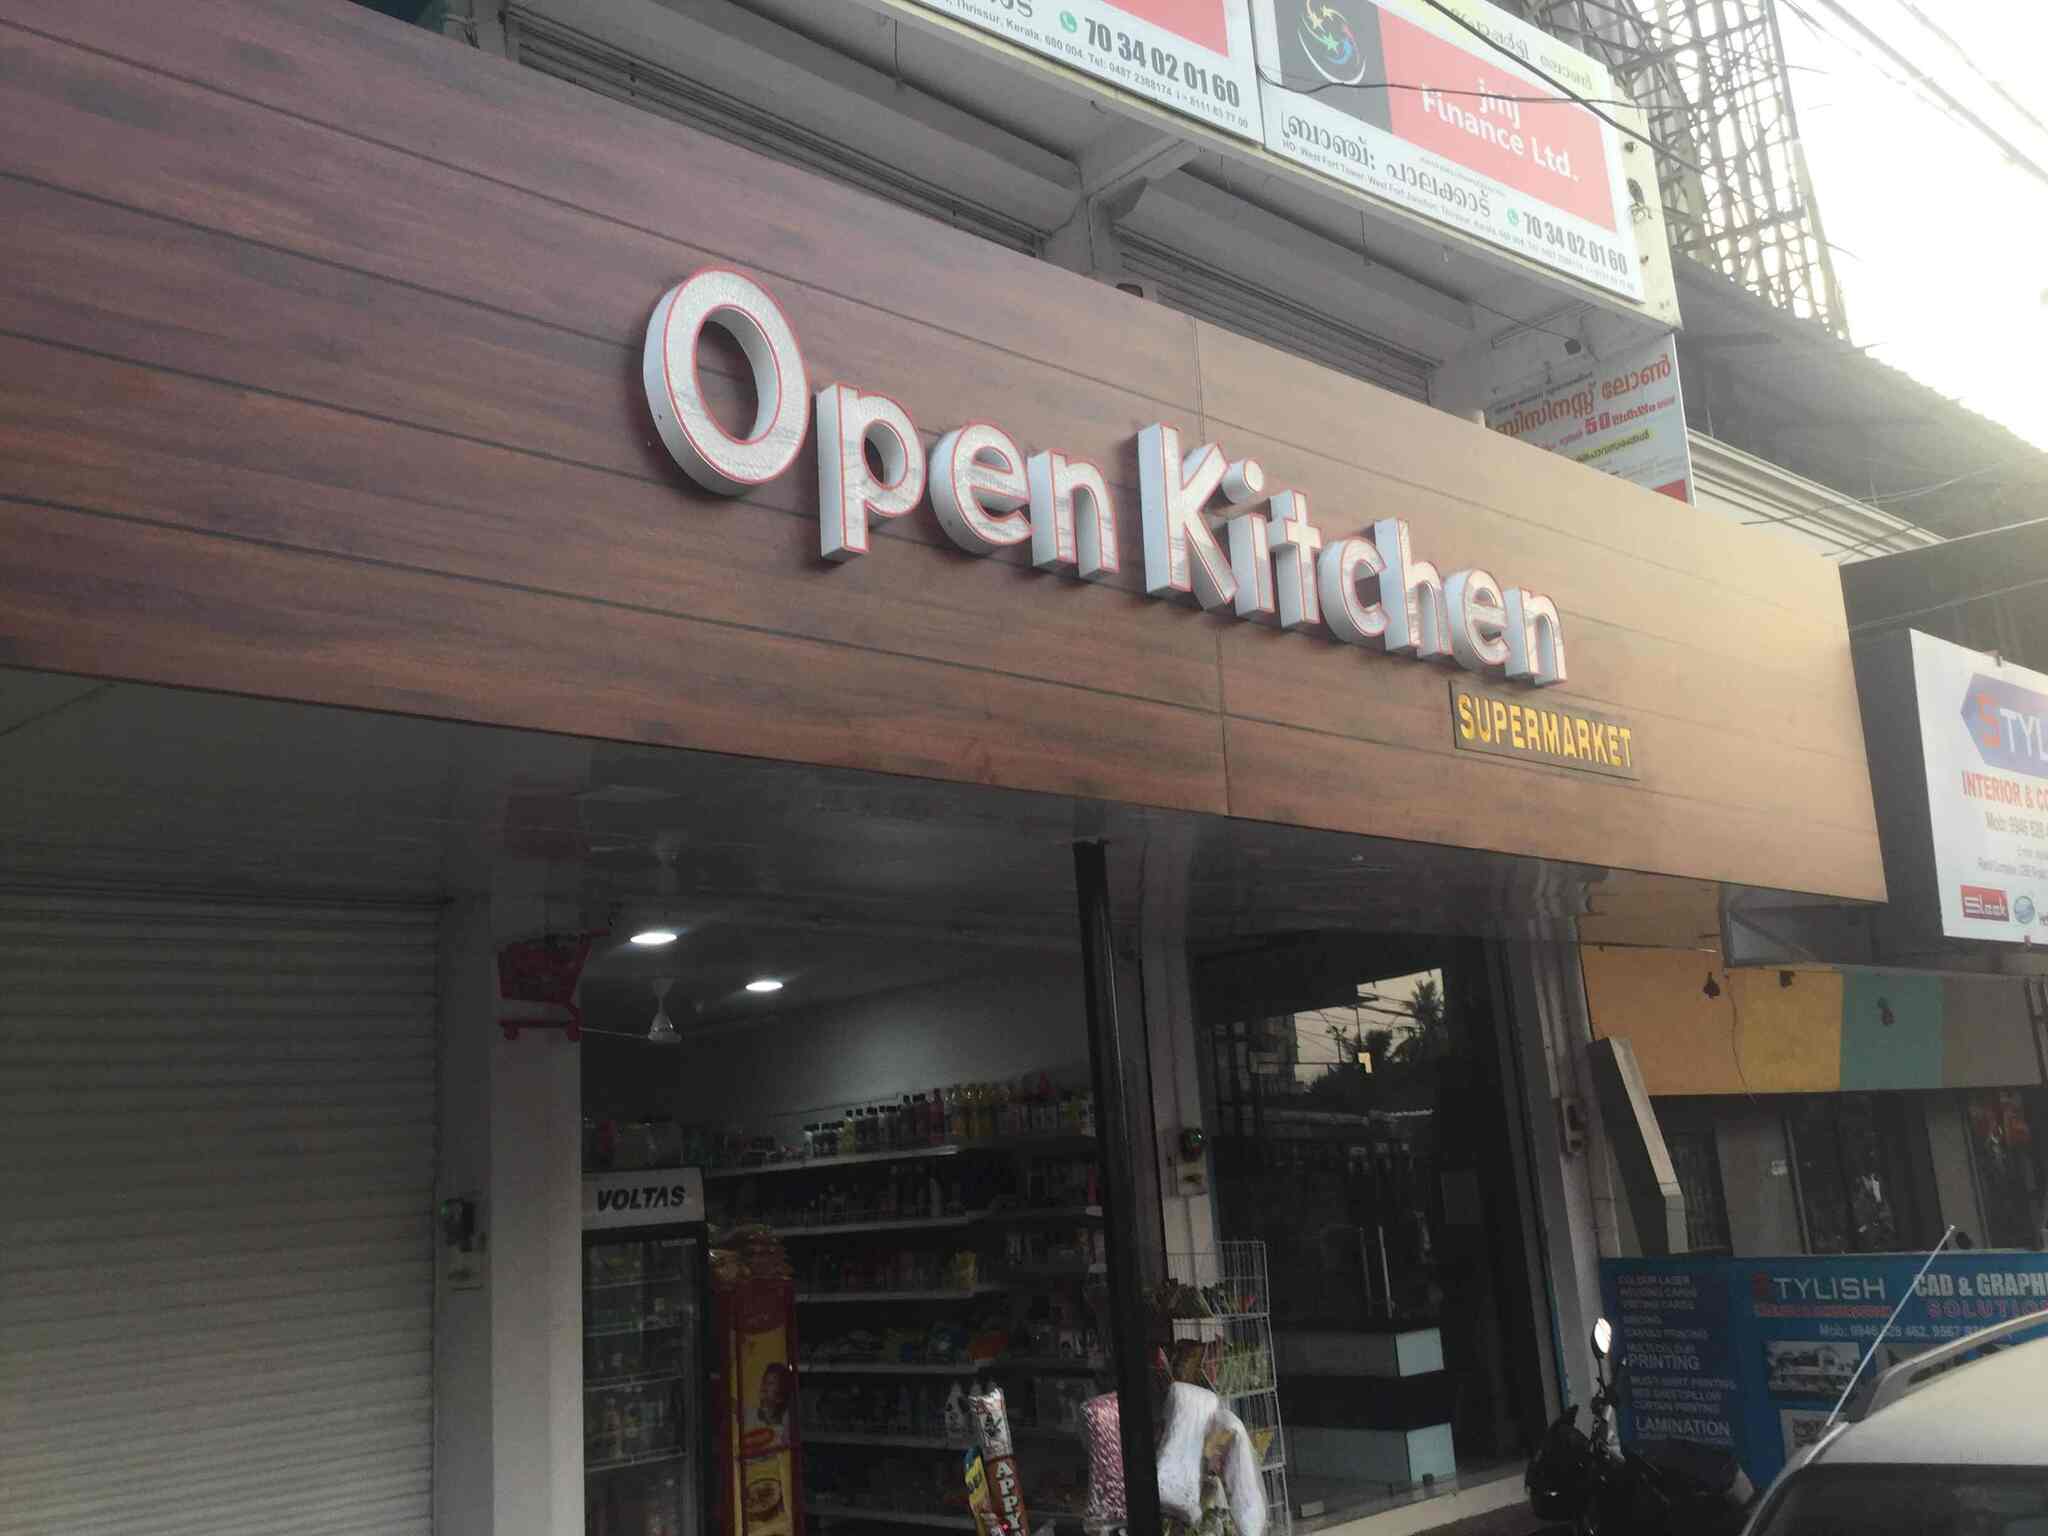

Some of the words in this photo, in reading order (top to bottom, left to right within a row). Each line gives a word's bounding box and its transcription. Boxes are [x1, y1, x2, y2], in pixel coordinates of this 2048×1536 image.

[1083, 17, 1113, 52] 70
[1116, 31, 1145, 68] 34
[1150, 46, 1180, 82] 02
[1182, 61, 1210, 96] 01
[1211, 75, 1241, 108] 60
[1421, 84, 1525, 156] Finance
[1532, 144, 1581, 183] Ltd.
[1522, 210, 1542, 239] 70
[1543, 221, 1565, 249] 34
[1567, 231, 1587, 258] 02
[1588, 241, 1607, 268] 01
[1607, 249, 1629, 276] 60
[643, 266, 1119, 578] Open
[1137, 422, 1568, 685] Kitchen
[1457, 692, 1634, 773] SUPERMARKET
[1961, 769, 2021, 809] INTERIOR
[596, 1185, 686, 1211] VOLTAS
[1752, 1272, 1887, 1300] STYLISH
[1914, 1273, 1954, 1297] CAD
[1958, 1277, 1973, 1297] &
[1627, 1352, 1701, 1370] PRINTING
[1635, 1415, 1731, 1436] LAMINATION
